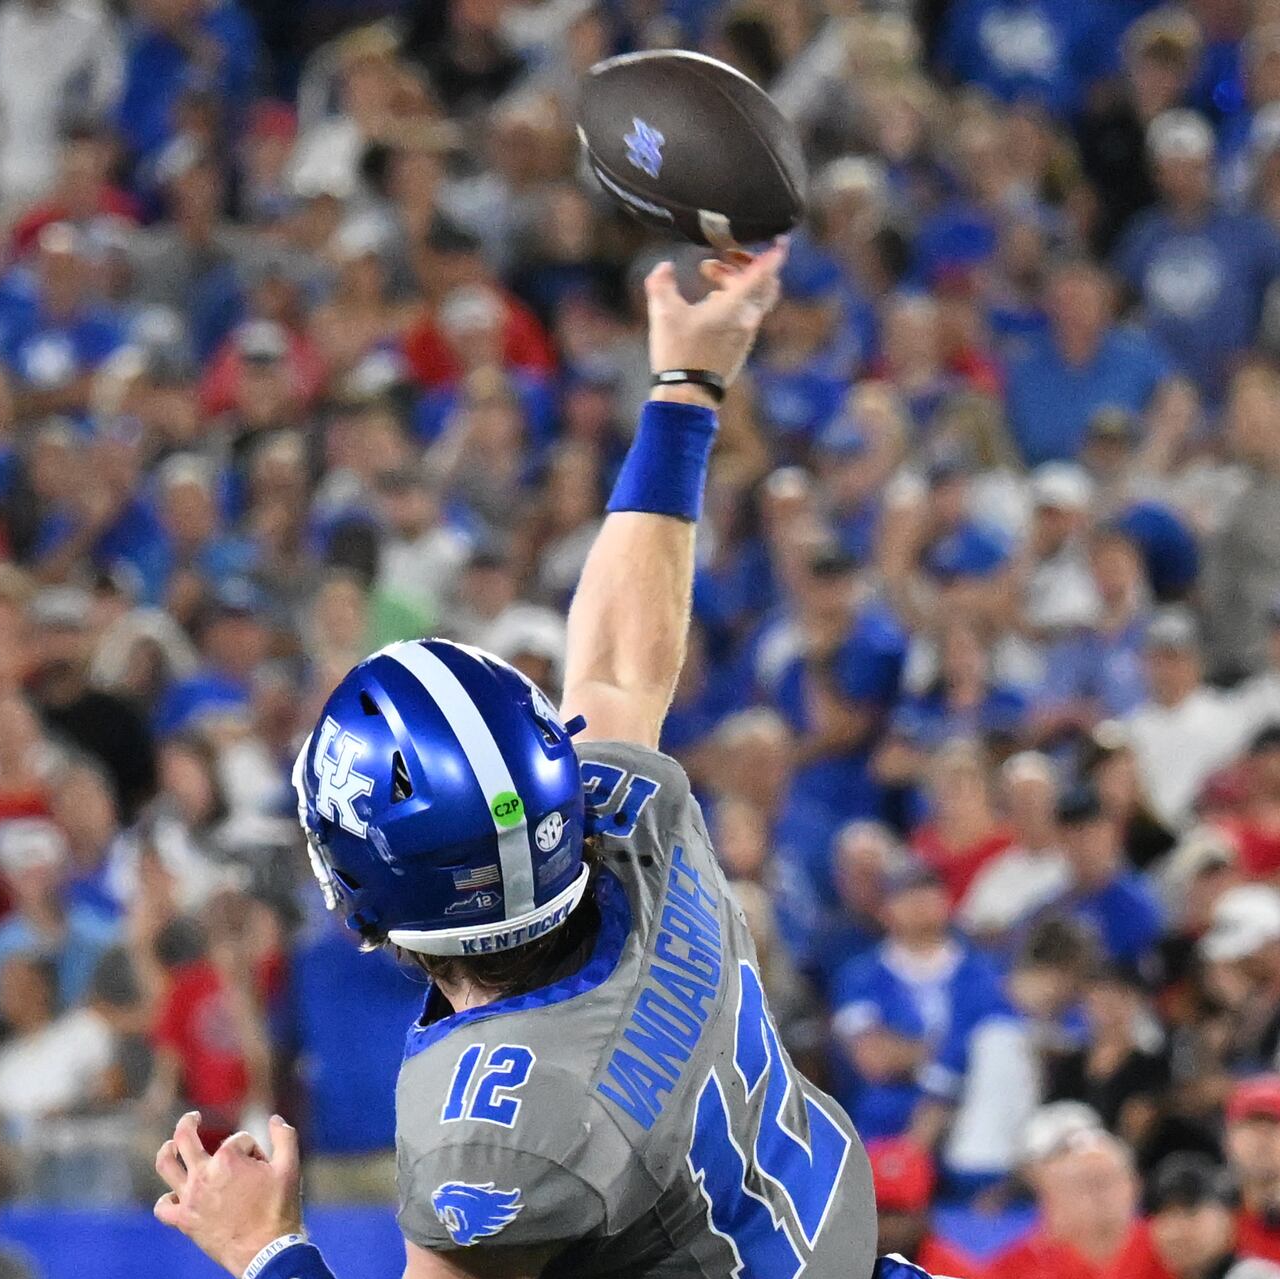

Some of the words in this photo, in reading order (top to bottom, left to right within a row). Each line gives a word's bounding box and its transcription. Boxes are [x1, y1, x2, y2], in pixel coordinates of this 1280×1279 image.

[314, 714, 376, 839] UK
[493, 798, 520, 818] C2P
[460, 897, 575, 954] KENTUCKY
[476, 895, 493, 909] 12
[439, 1043, 537, 1129] 12
